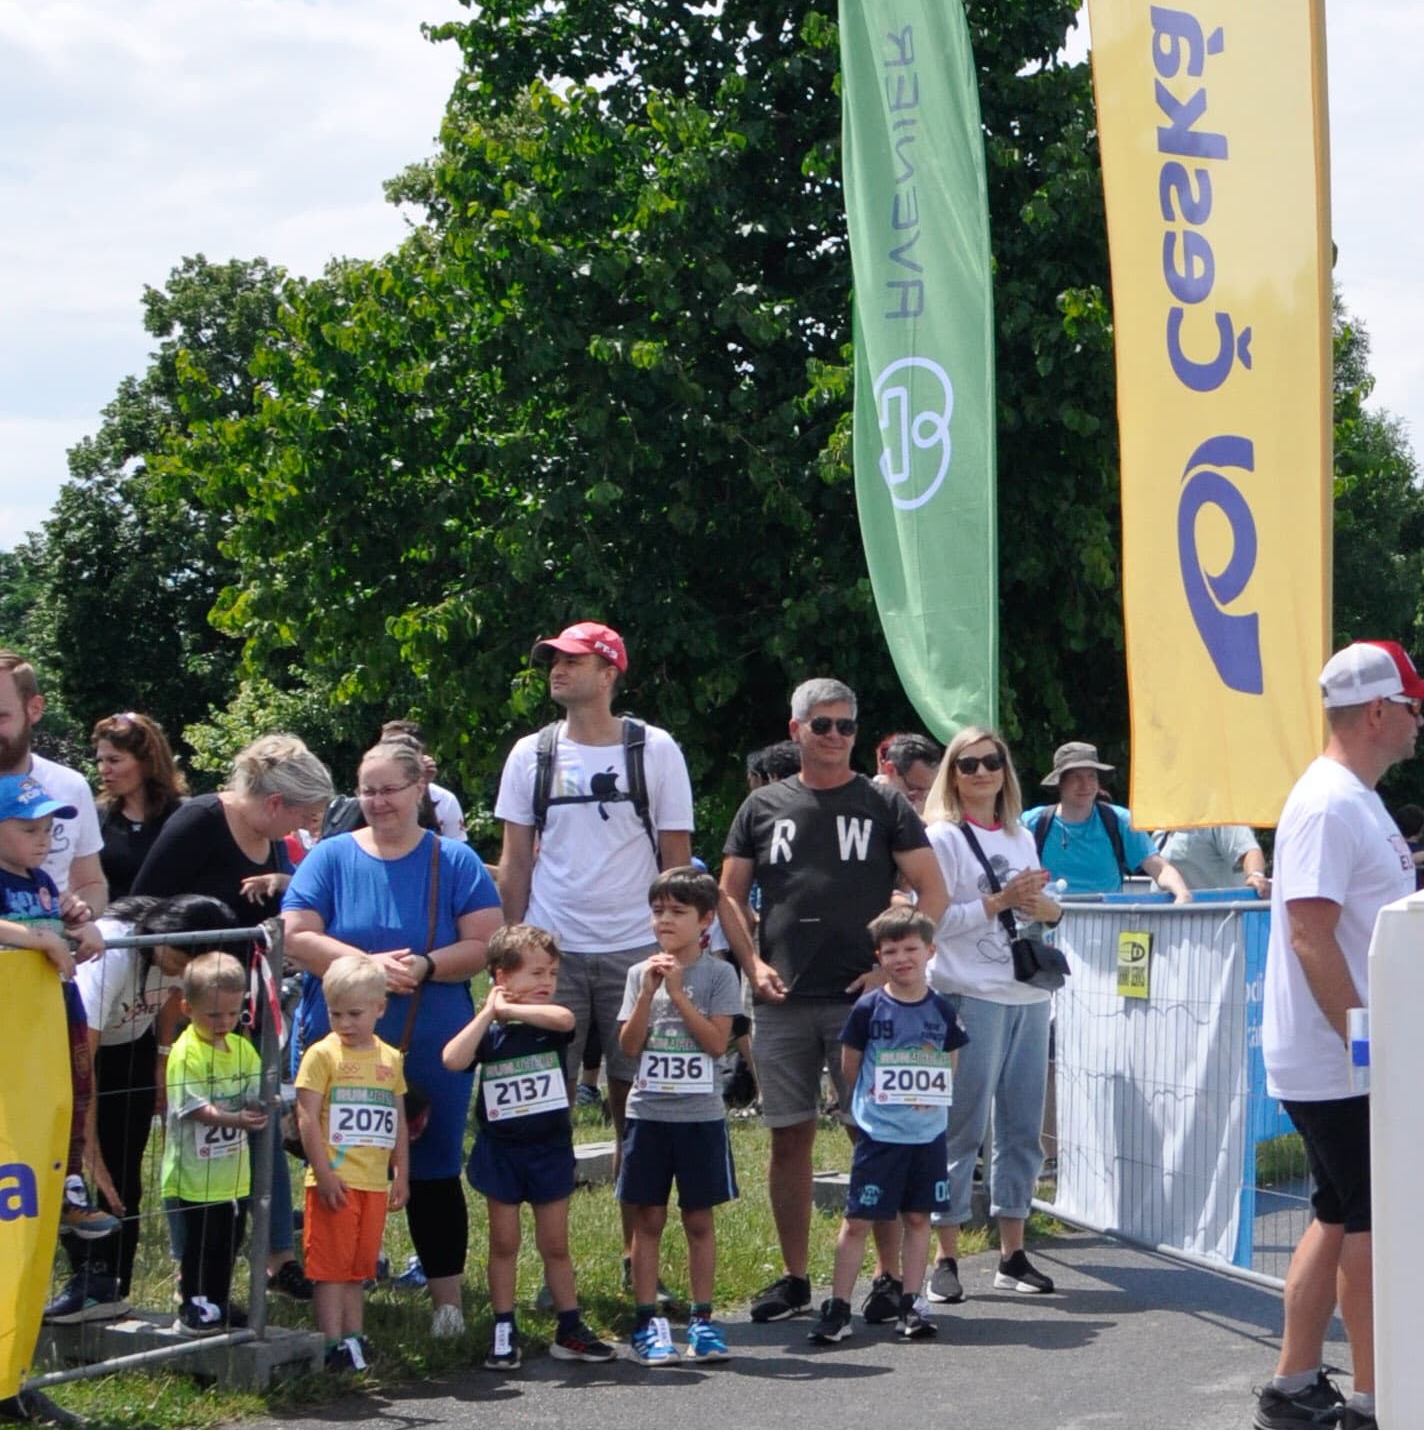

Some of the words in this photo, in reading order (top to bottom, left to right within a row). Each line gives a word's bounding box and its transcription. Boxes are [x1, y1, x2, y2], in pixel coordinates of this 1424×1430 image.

[647, 1055, 703, 1079] 2136
[494, 1074, 551, 1106] 2137
[882, 1069, 947, 1092] 2004
[339, 1107, 394, 1134] 2076
